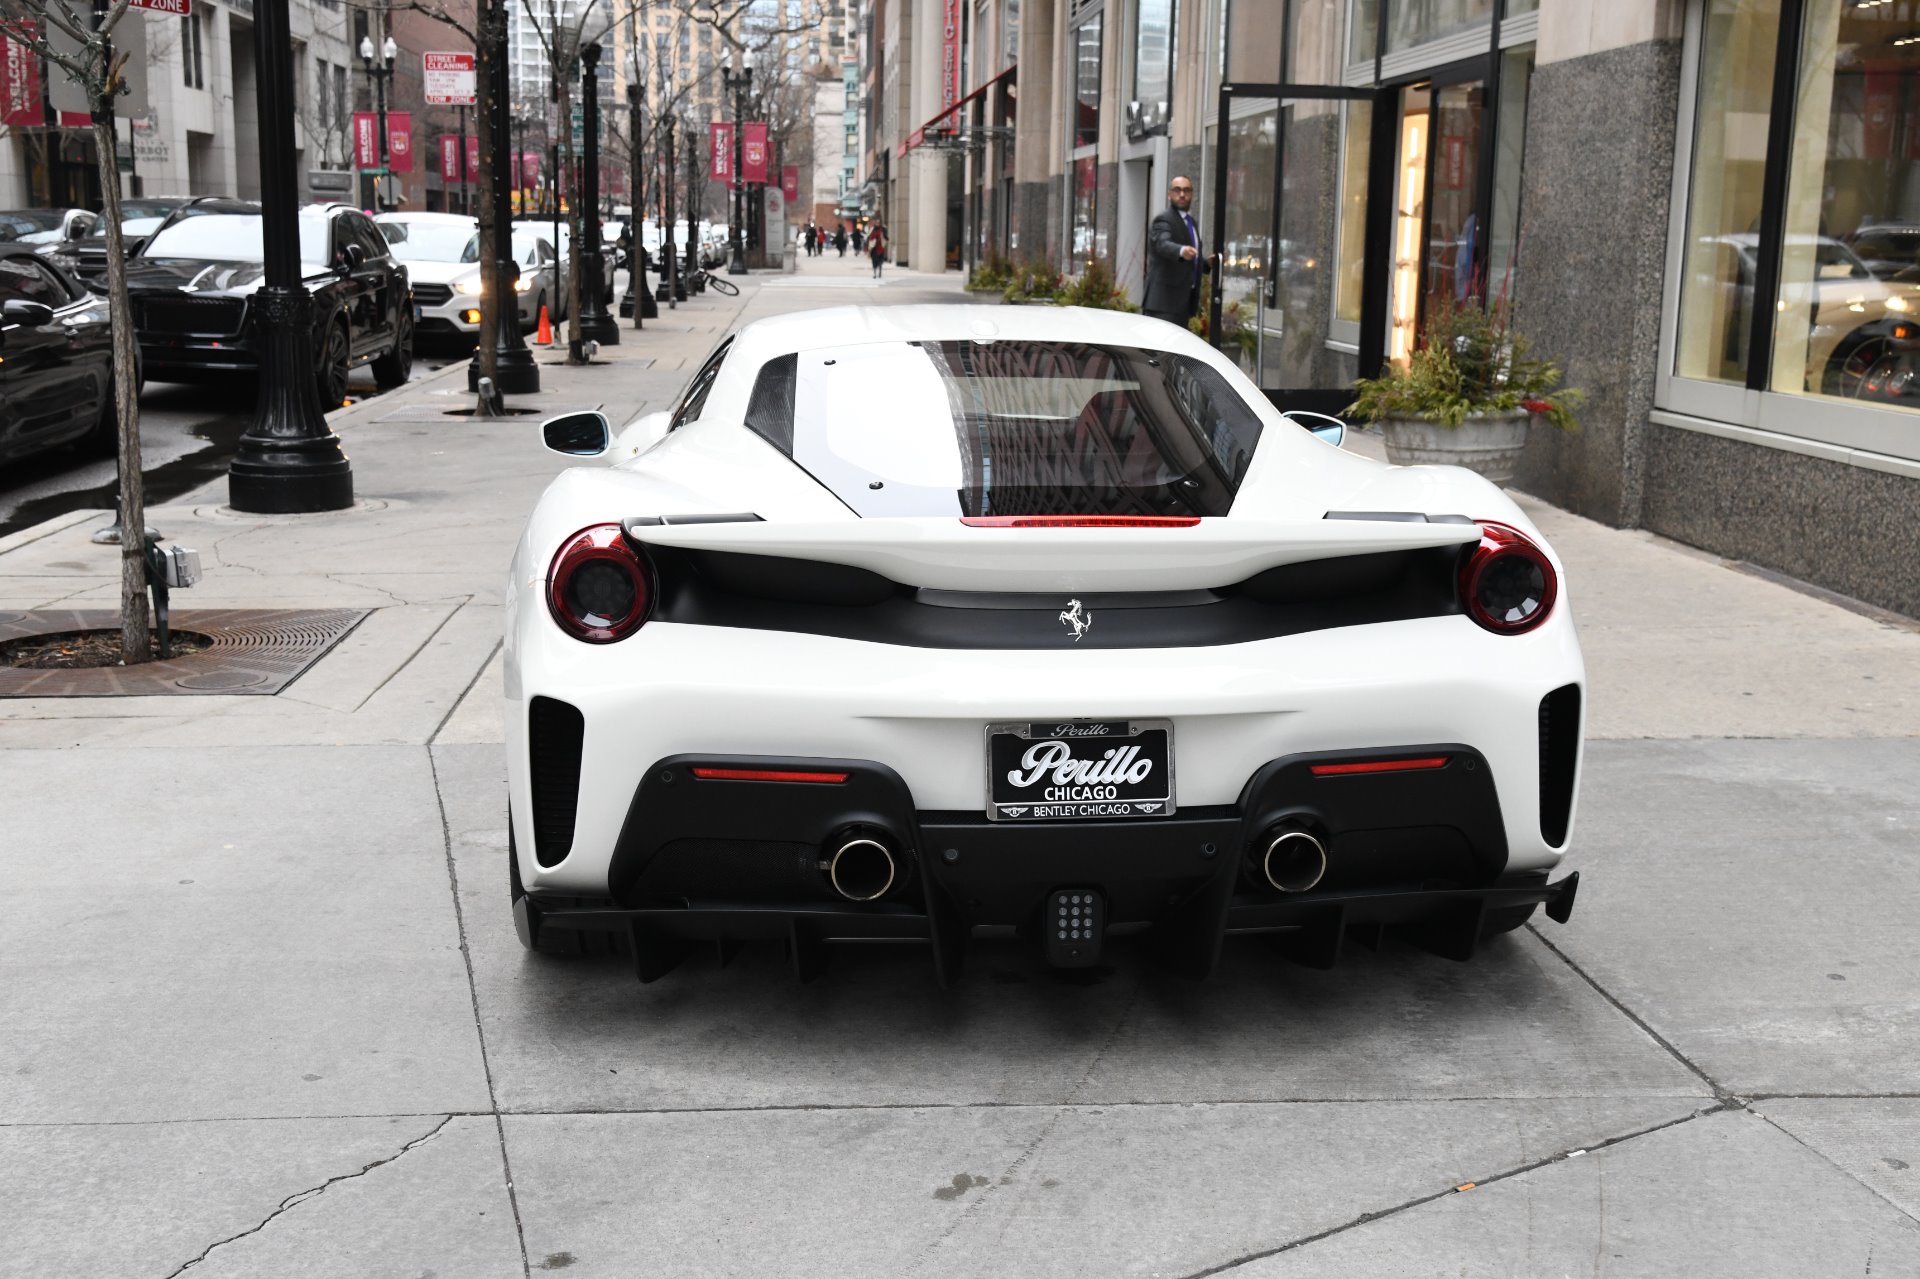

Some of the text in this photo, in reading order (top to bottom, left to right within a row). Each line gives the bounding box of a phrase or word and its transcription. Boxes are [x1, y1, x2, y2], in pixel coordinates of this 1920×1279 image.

[150, 0, 184, 13] ZONE
[428, 55, 456, 63] STREET
[428, 62, 469, 71] CLEANING
[359, 119, 369, 164] WELCOME
[1051, 724, 1109, 737] Perillo
[1007, 741, 1153, 788] Perillo
[1044, 786, 1117, 800] CHICAGO
[1034, 806, 1077, 817] BENTLEY
[1079, 804, 1131, 815] CHICAGO
